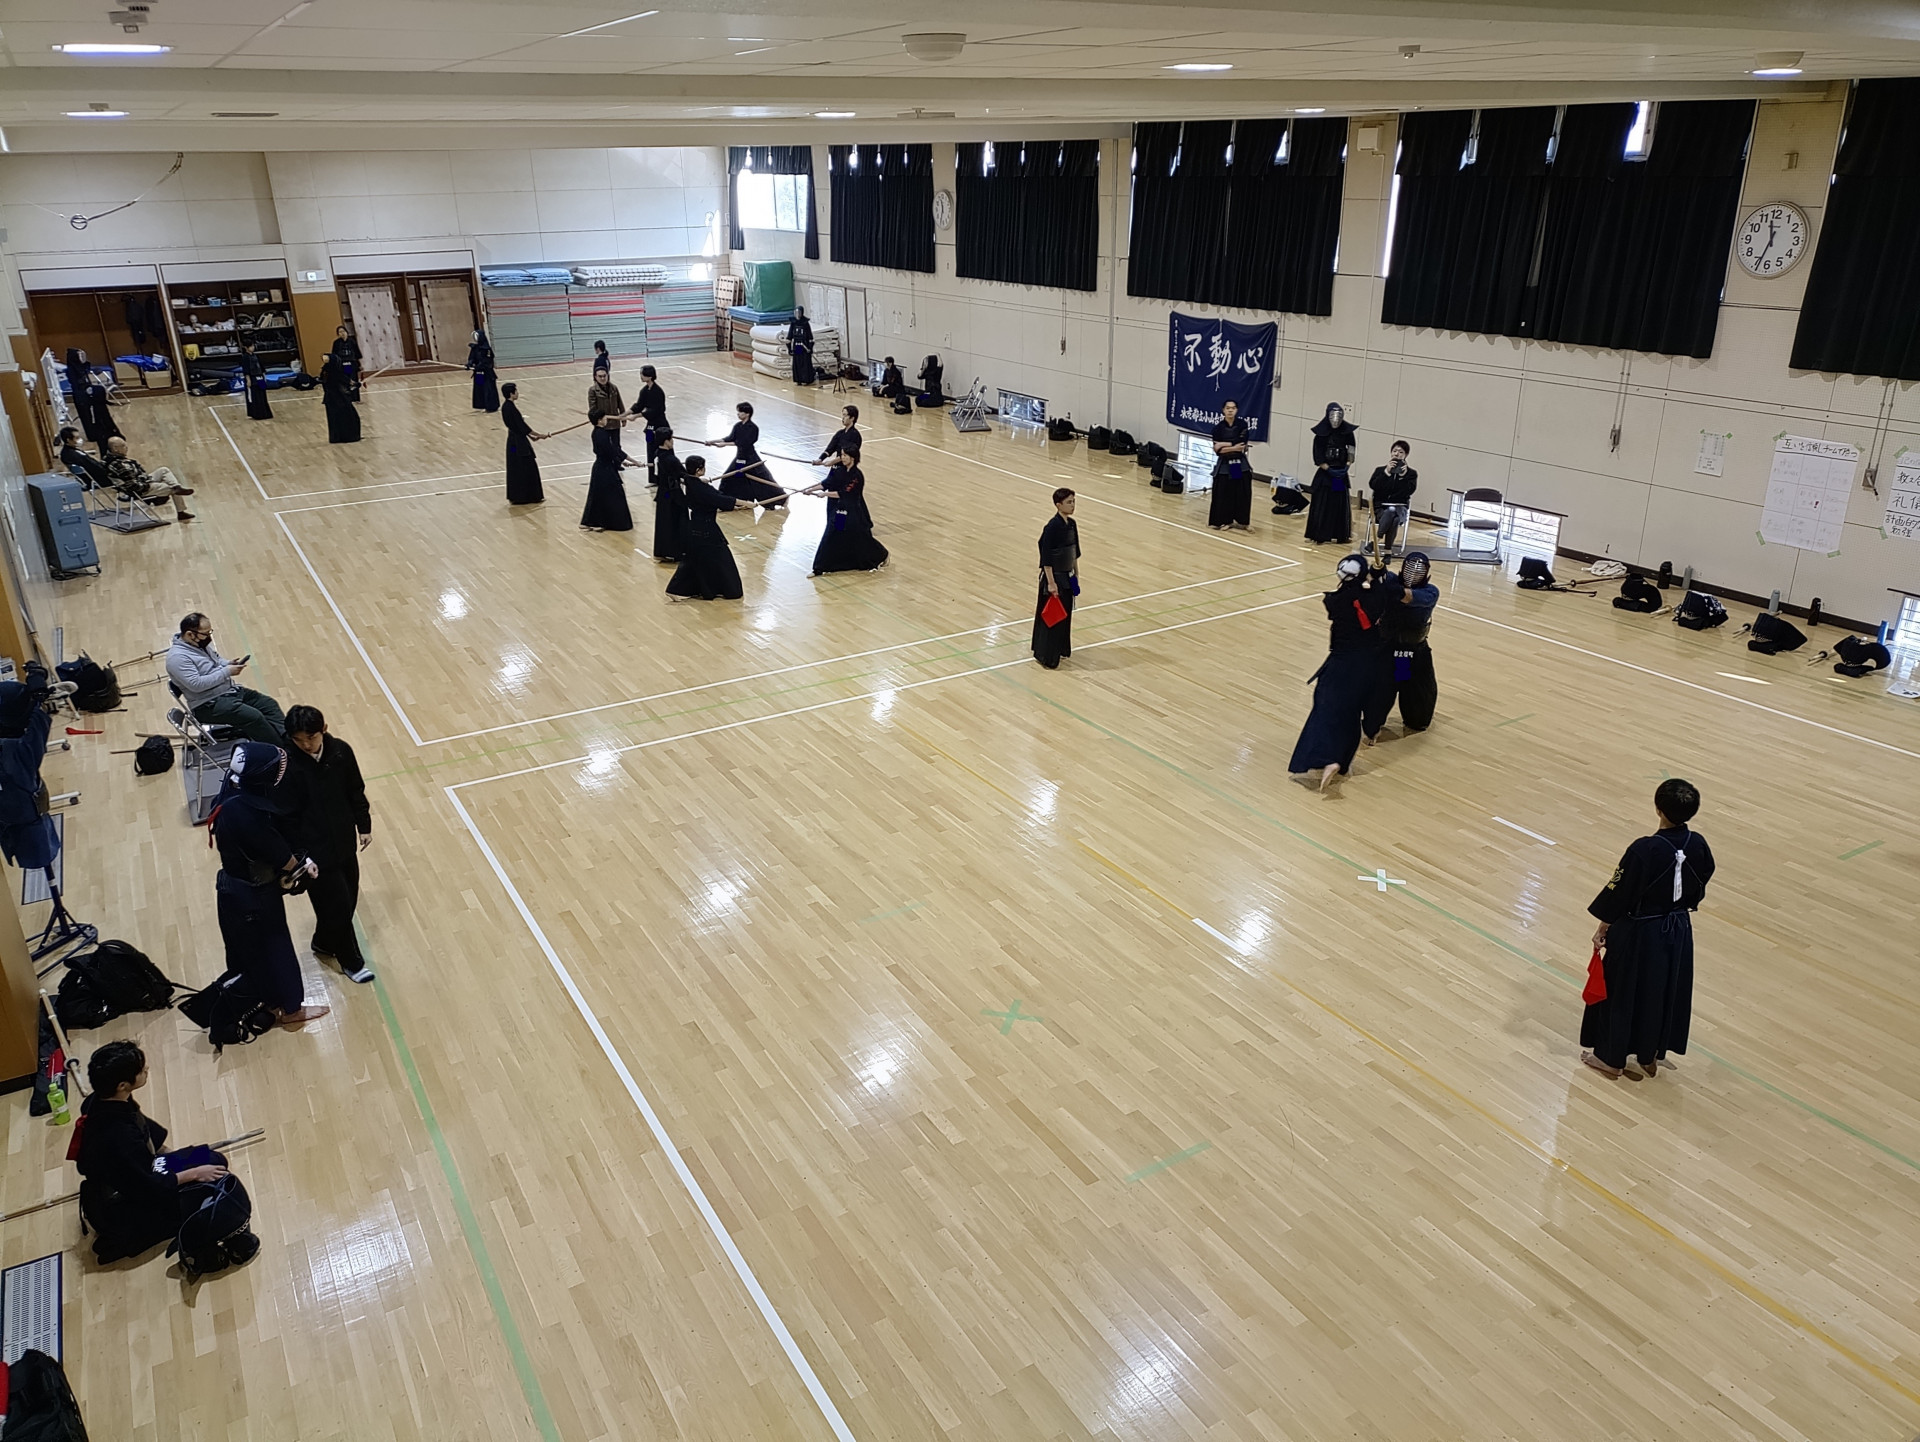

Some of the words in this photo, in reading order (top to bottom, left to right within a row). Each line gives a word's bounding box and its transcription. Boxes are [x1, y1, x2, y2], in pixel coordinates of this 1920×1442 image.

[1759, 213, 1769, 223] 11
[1771, 209, 1783, 219] 12
[1786, 214, 1791, 224] 1
[1749, 222, 1761, 233] 10
[1791, 223, 1799, 233] 2
[1745, 235, 1752, 244] 9
[1792, 237, 1800, 246] 3
[1746, 247, 1753, 257] 8
[1786, 249, 1793, 258] 4
[1754, 256, 1762, 266] 7
[1763, 260, 1771, 270] 6
[1775, 257, 1784, 267] 5
[1184, 333, 1263, 378] 不動心
